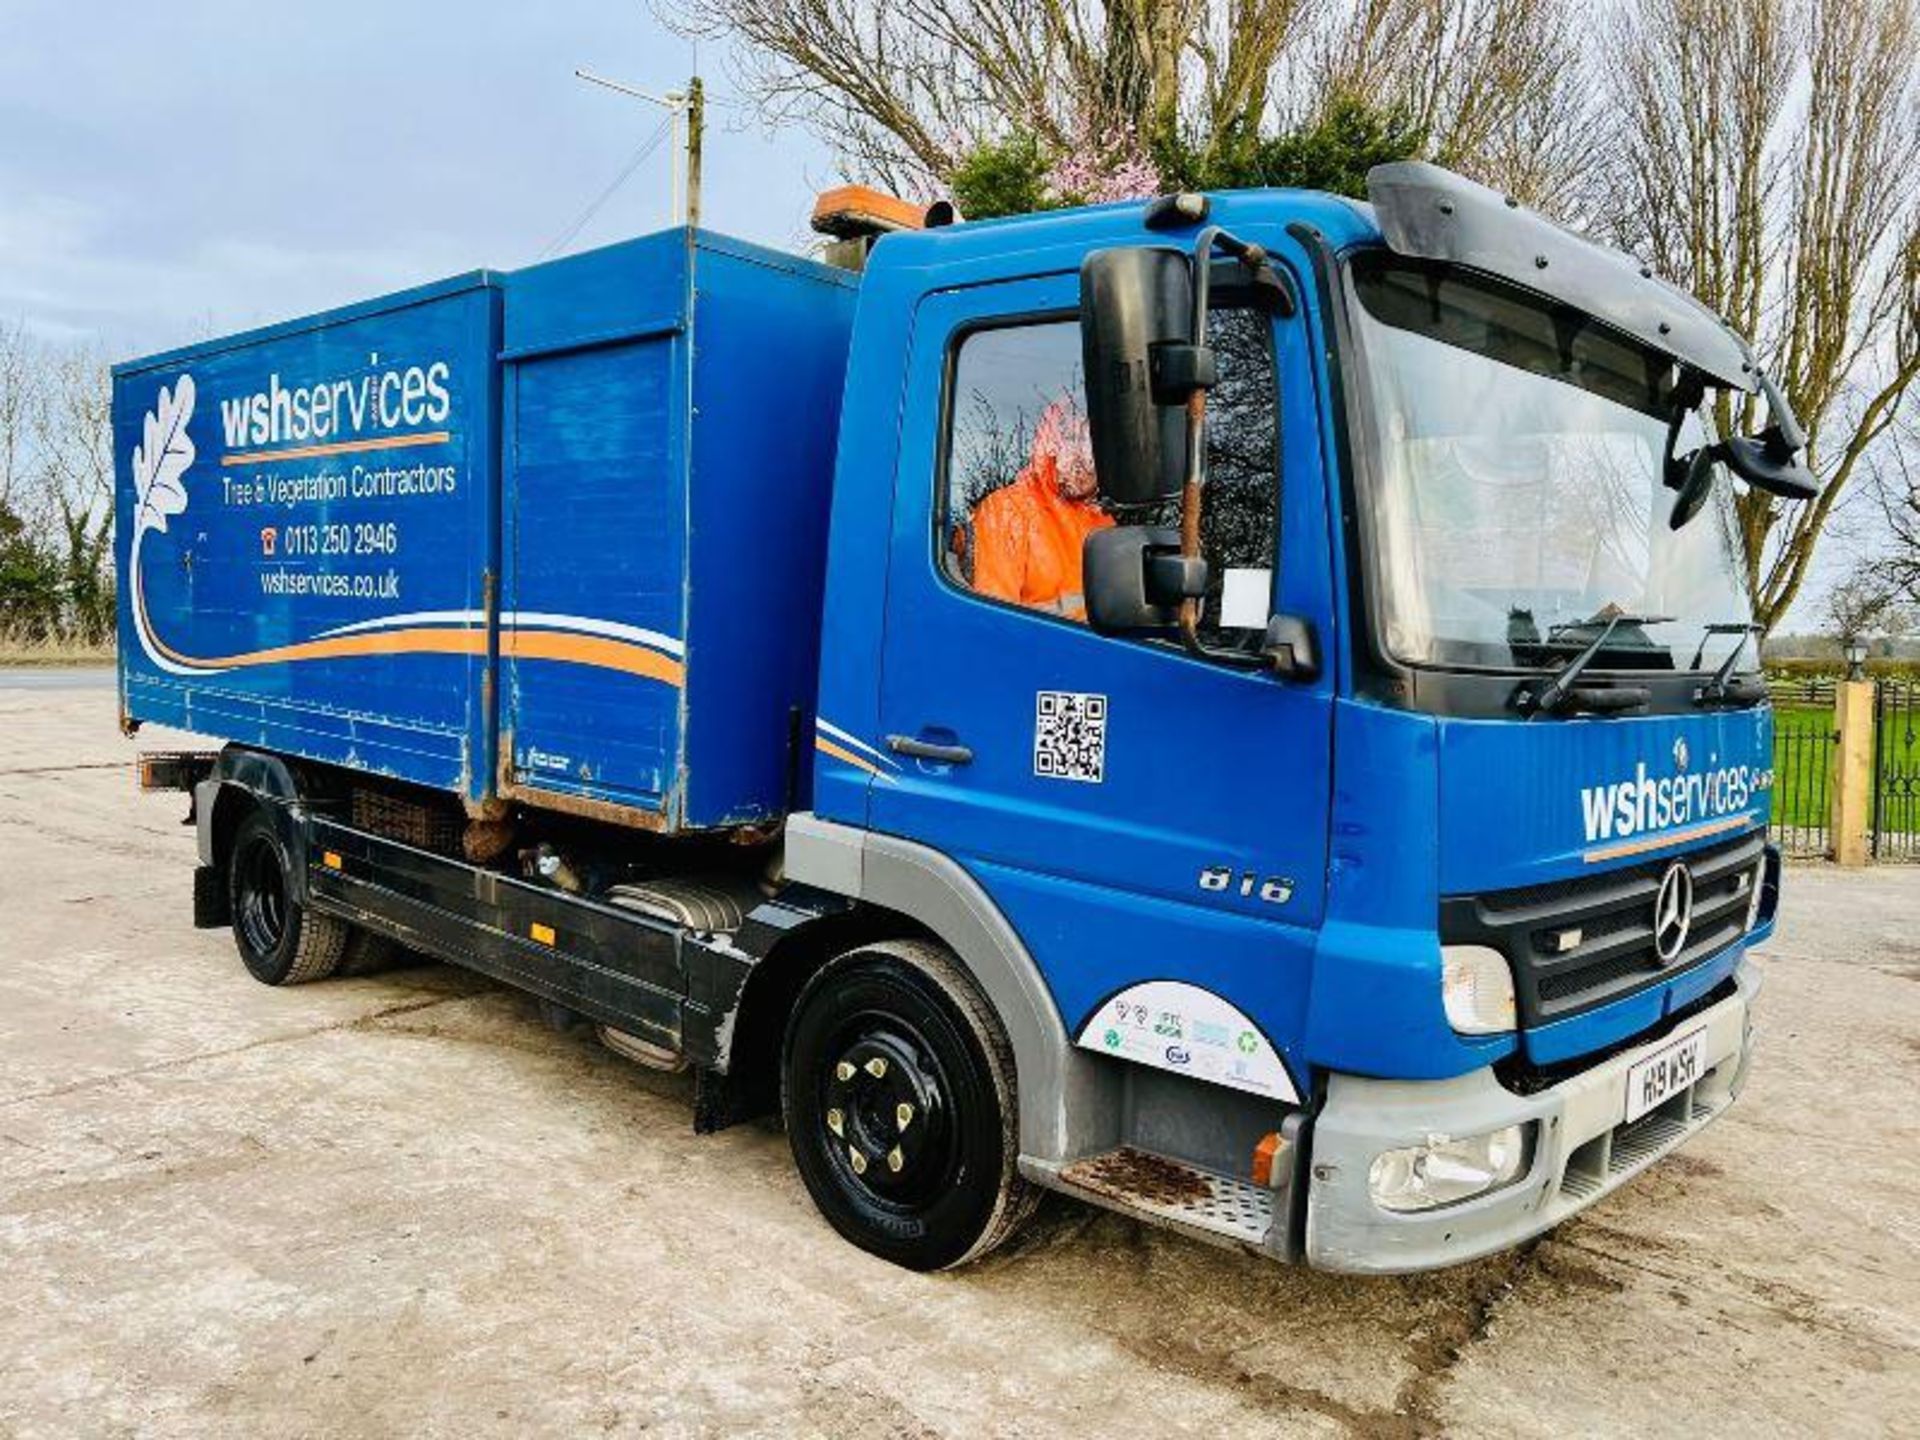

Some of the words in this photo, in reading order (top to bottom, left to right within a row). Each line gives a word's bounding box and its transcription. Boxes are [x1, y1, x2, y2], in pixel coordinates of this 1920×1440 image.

[221, 353, 450, 448] wshservices
[223, 476, 252, 505] Tree
[255, 474, 265, 502] &
[267, 469, 347, 509] Vegetation
[352, 463, 456, 498] Contractors
[285, 526, 318, 554] 0113
[321, 524, 351, 554] 250
[354, 522, 397, 554] 2946
[261, 567, 400, 599] wshservices.co.uk
[1581, 752, 1748, 842] wshservices
[1199, 866, 1295, 904] 816
